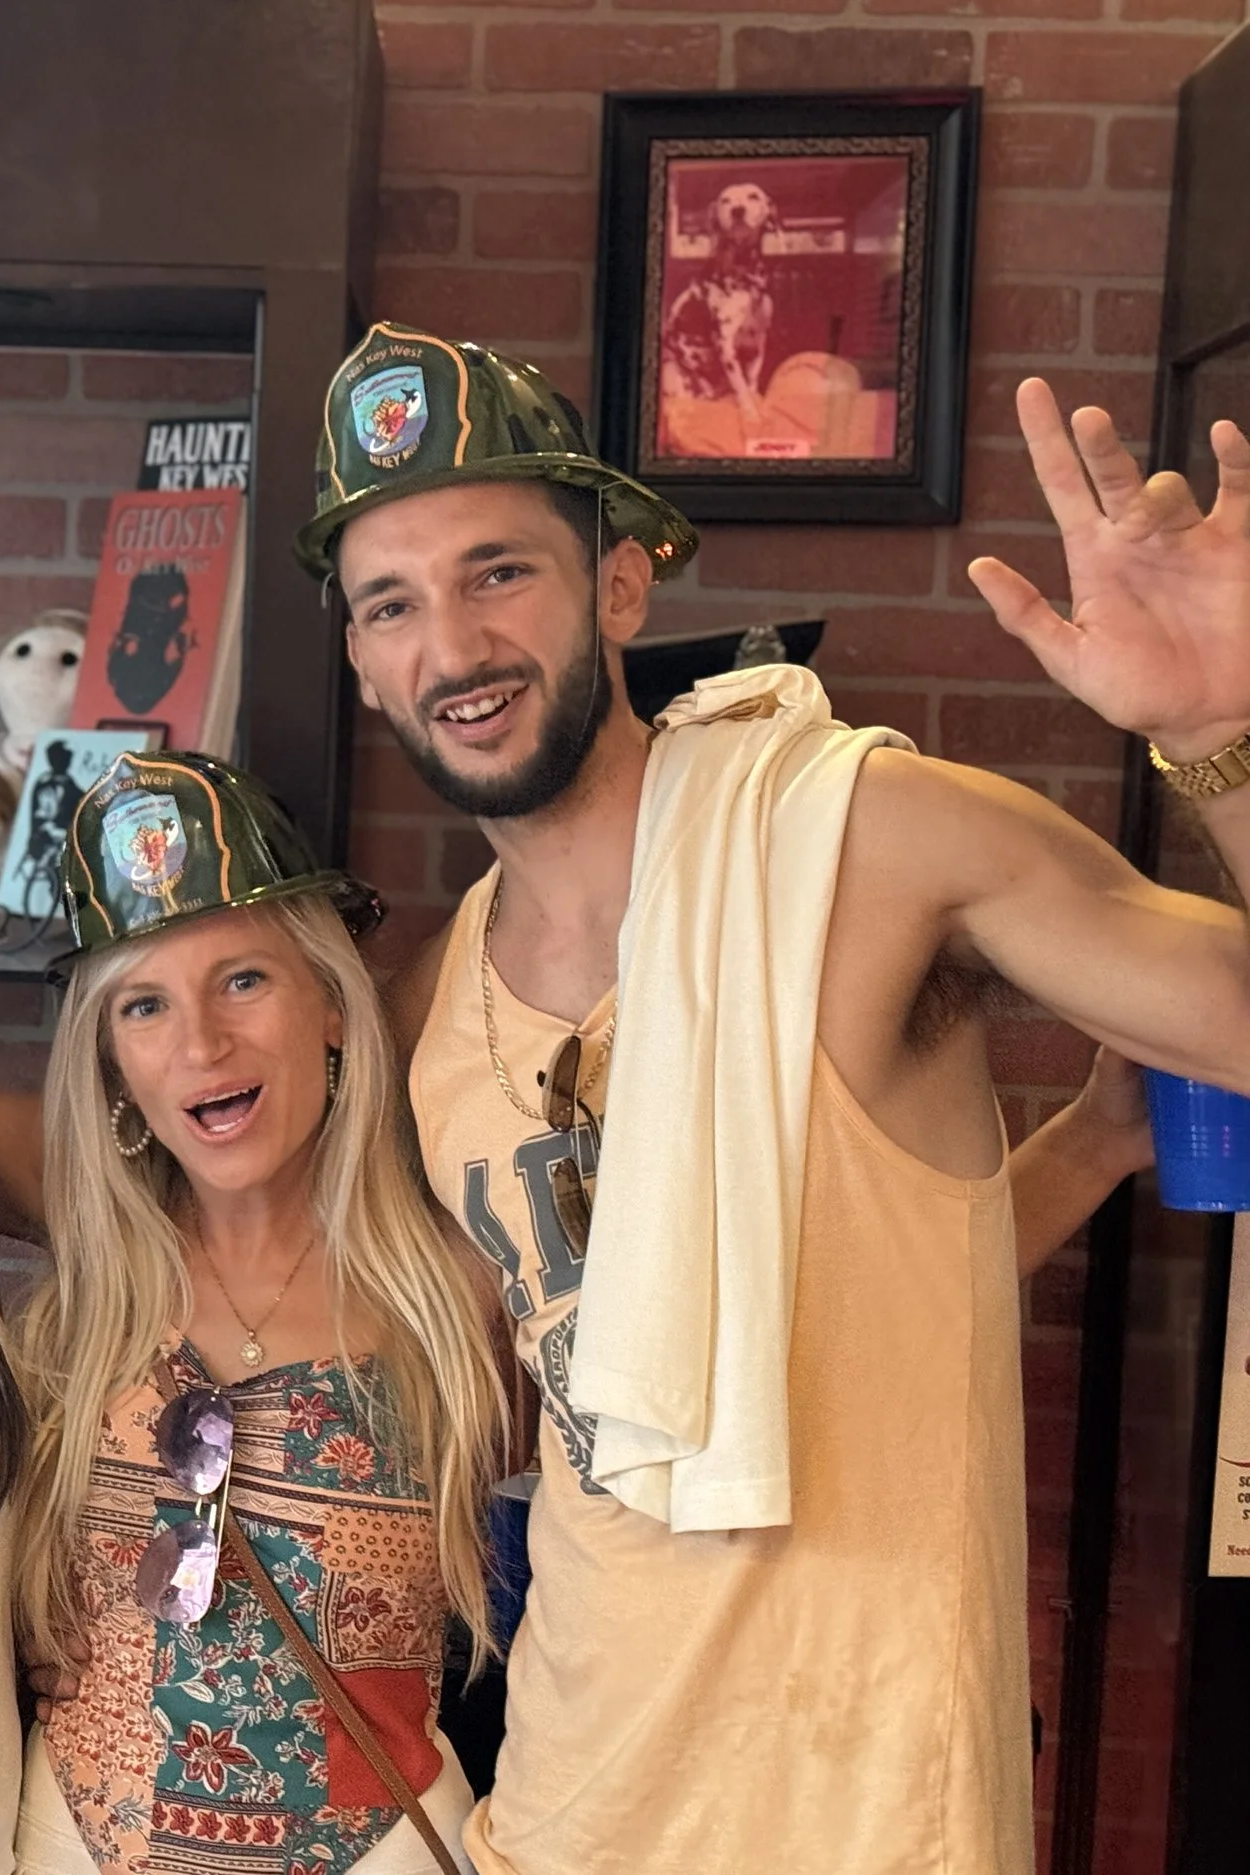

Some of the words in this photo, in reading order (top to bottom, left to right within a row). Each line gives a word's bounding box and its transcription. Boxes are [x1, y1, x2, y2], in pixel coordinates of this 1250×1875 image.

[365, 350, 387, 364] Key
[390, 345, 422, 359] West
[203, 464, 248, 491] WES
[116, 505, 230, 552] GHOSTS
[115, 776, 137, 791] Key
[139, 774, 174, 788] West
